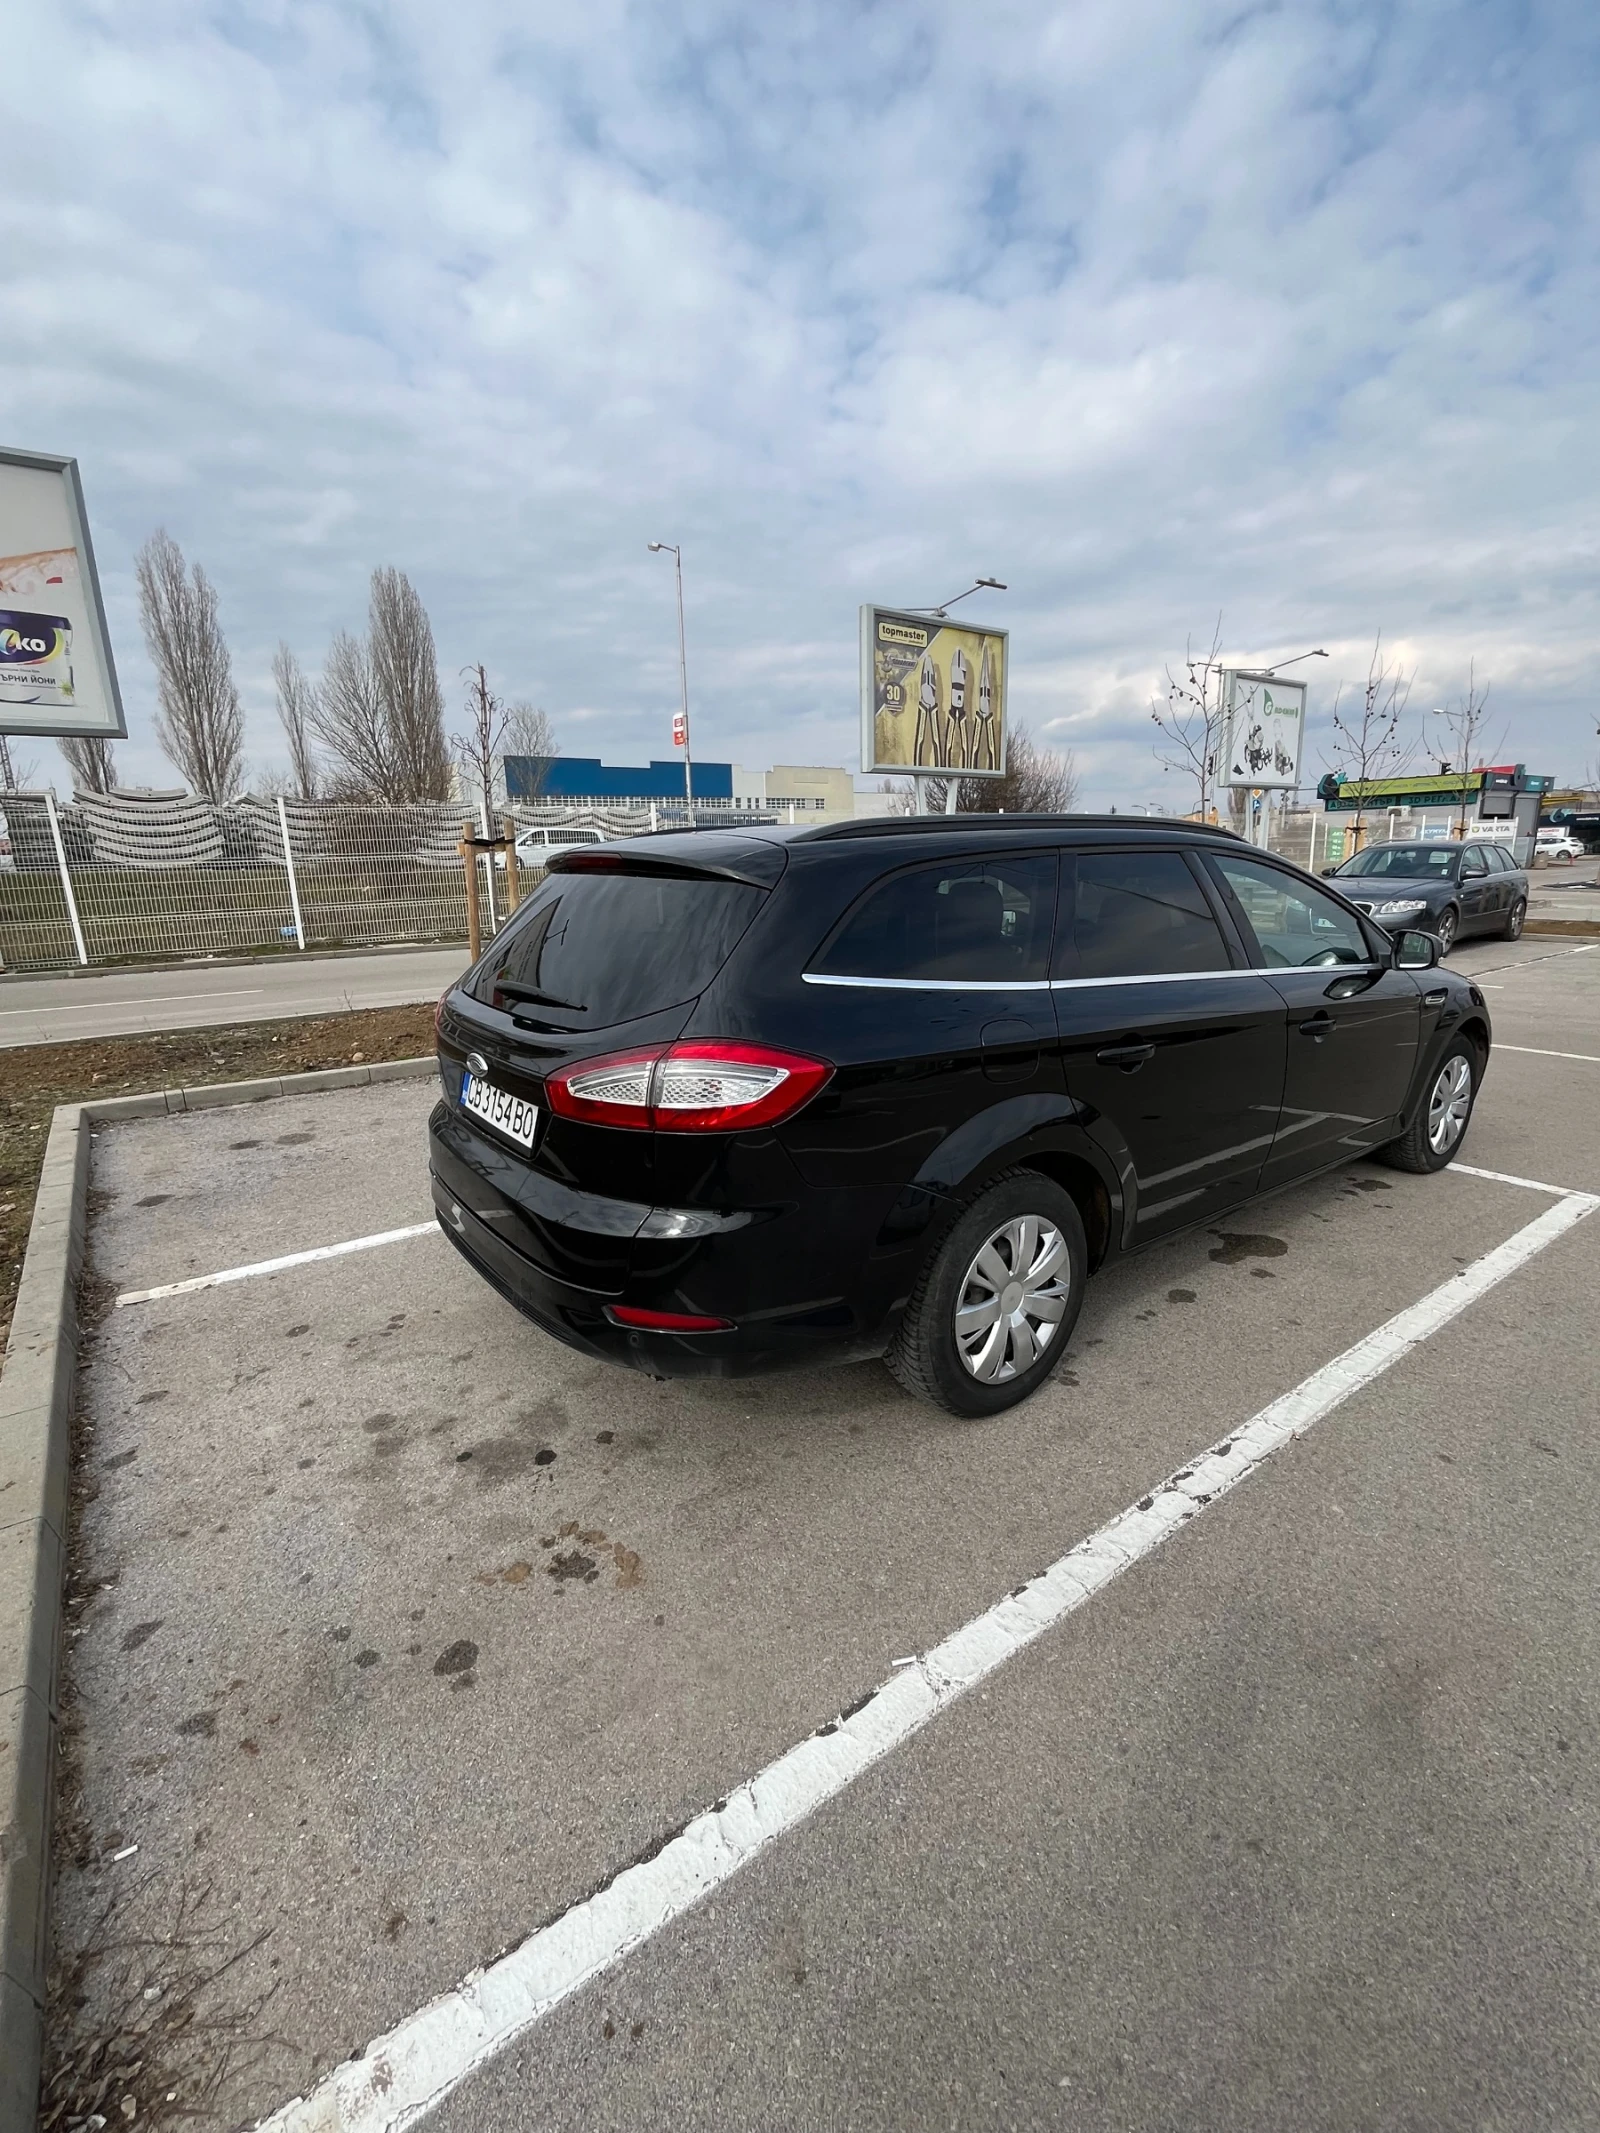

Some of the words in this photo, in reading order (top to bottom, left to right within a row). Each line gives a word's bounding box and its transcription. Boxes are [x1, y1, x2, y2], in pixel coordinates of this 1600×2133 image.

[882, 625, 925, 641] topmaster
[30, 674, 56, 685] ЙОНИ
[886, 685, 901, 701] 30
